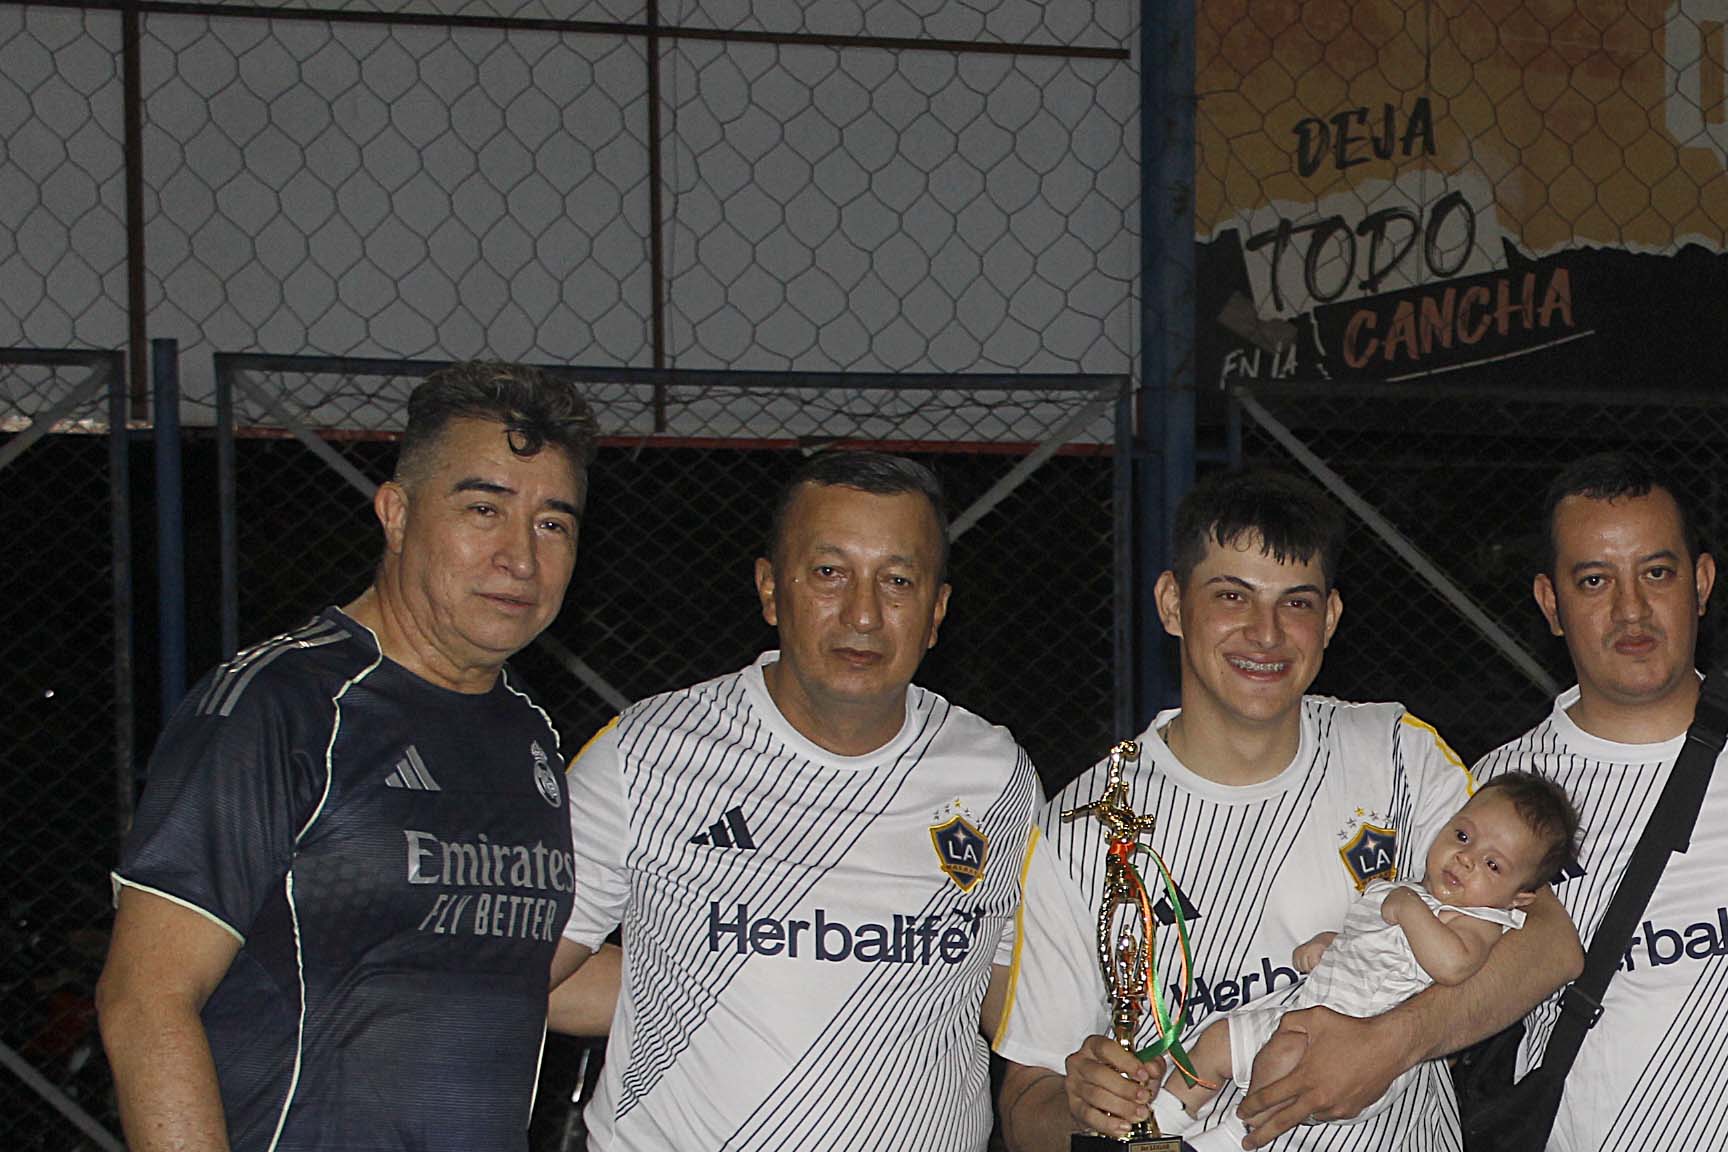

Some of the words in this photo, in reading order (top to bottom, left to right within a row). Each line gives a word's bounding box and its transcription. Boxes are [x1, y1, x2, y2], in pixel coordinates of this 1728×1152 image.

[1292, 98, 1436, 177] DEJA
[1247, 192, 1477, 312] TODO
[1342, 268, 1575, 369] CANCHA
[404, 830, 575, 894] Emirates
[948, 839, 978, 865] LA
[1360, 847, 1391, 874] LA
[419, 893, 469, 933] FLY
[474, 895, 559, 943] BETTER
[709, 901, 970, 966] Herbalife
